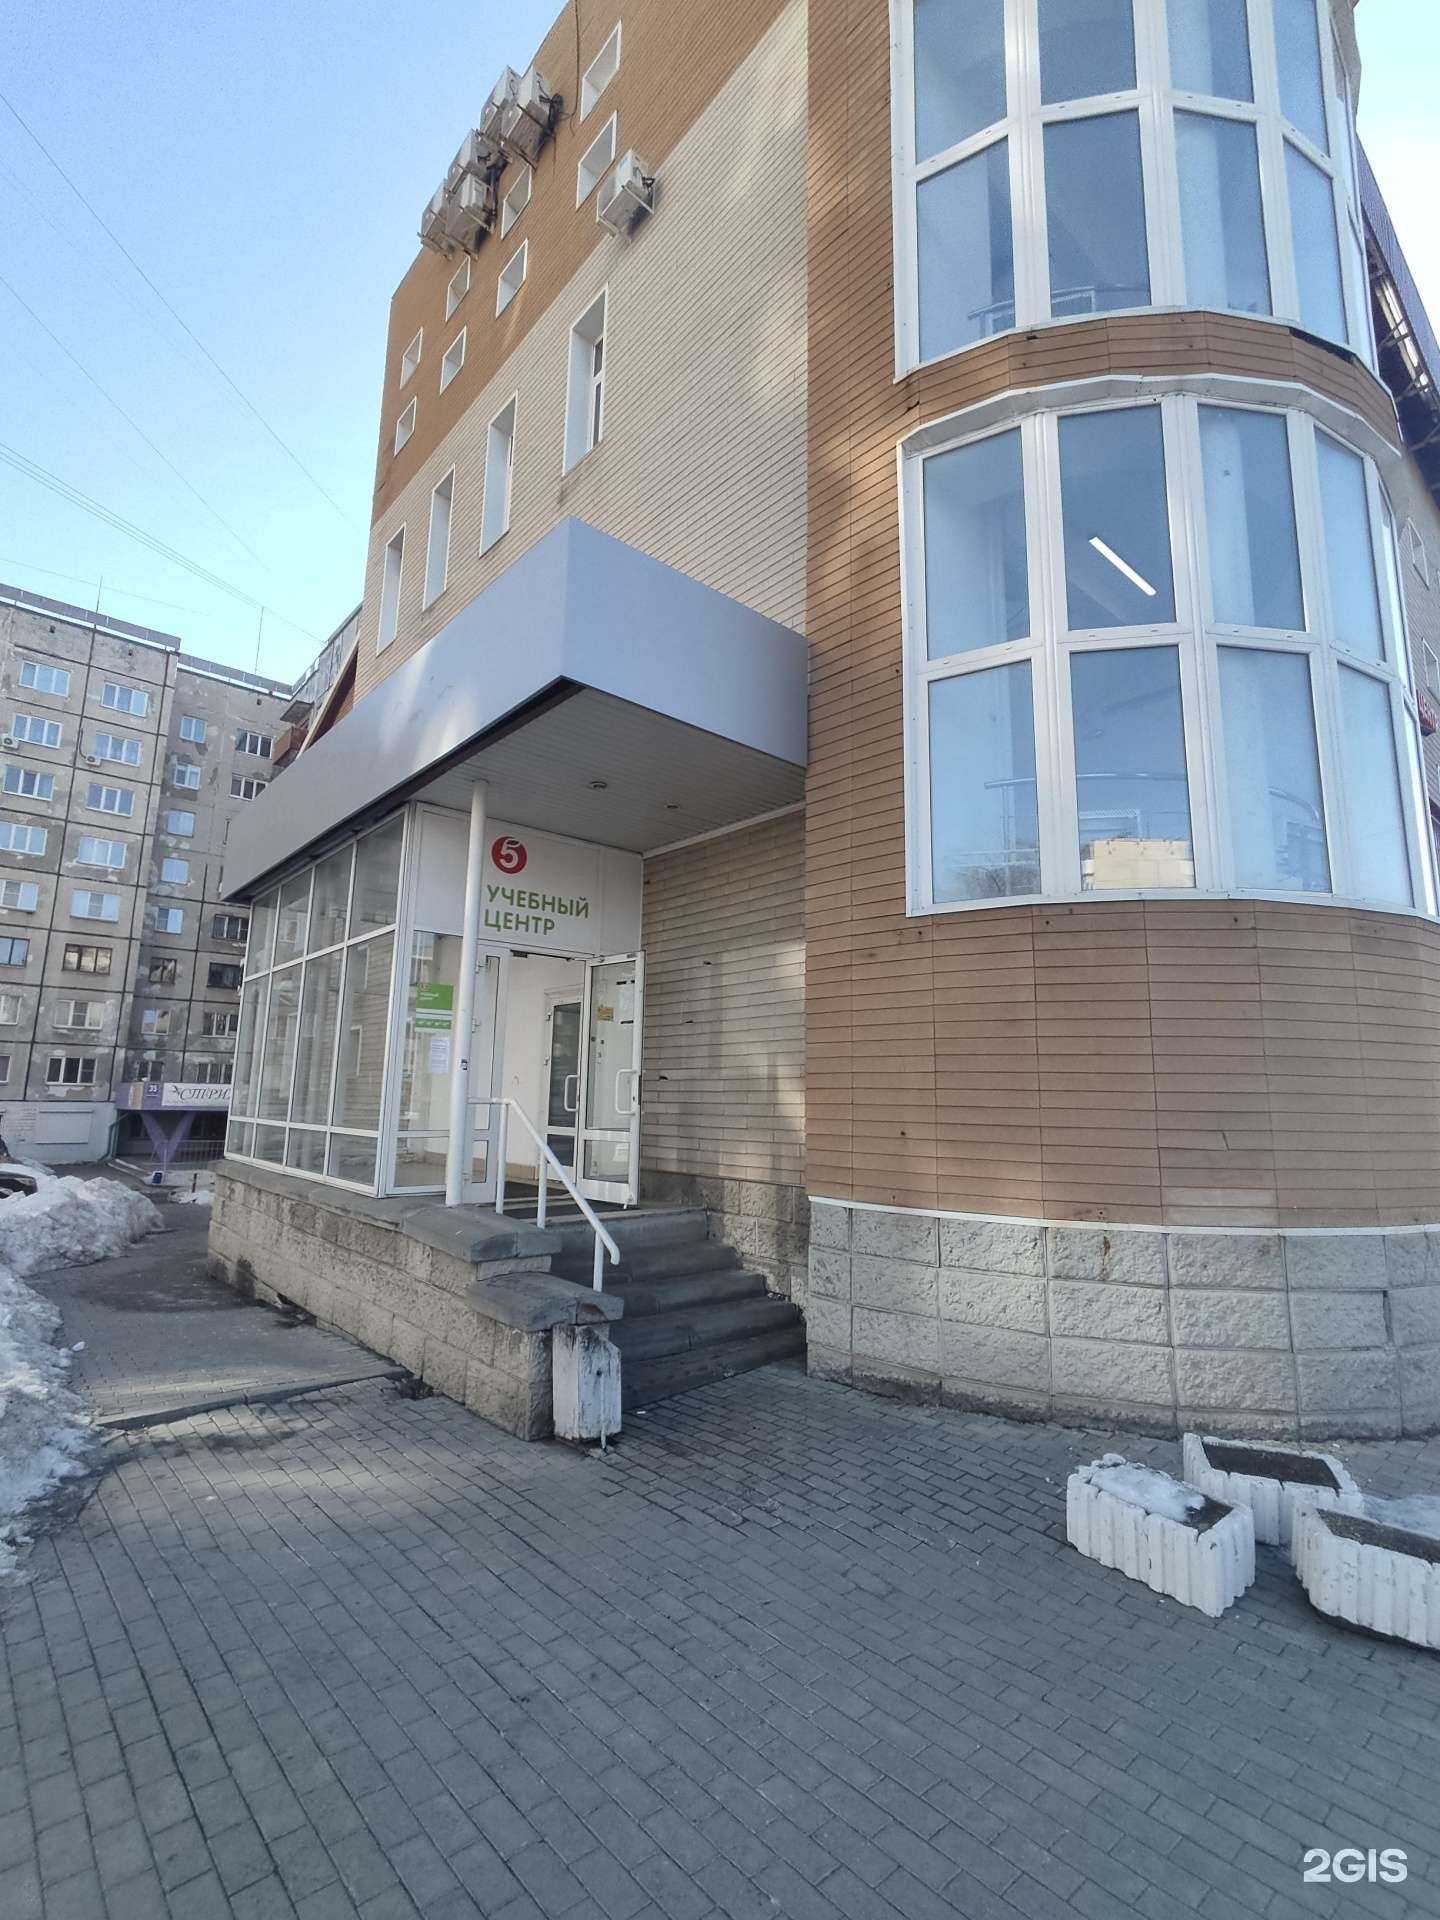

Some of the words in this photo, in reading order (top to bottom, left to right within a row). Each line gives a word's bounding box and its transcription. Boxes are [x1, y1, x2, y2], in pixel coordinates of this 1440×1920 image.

[499, 838, 520, 869] 5
[487, 884, 589, 919] УЧЕБНЫЙ
[484, 908, 555, 936] ЦЕНТР
